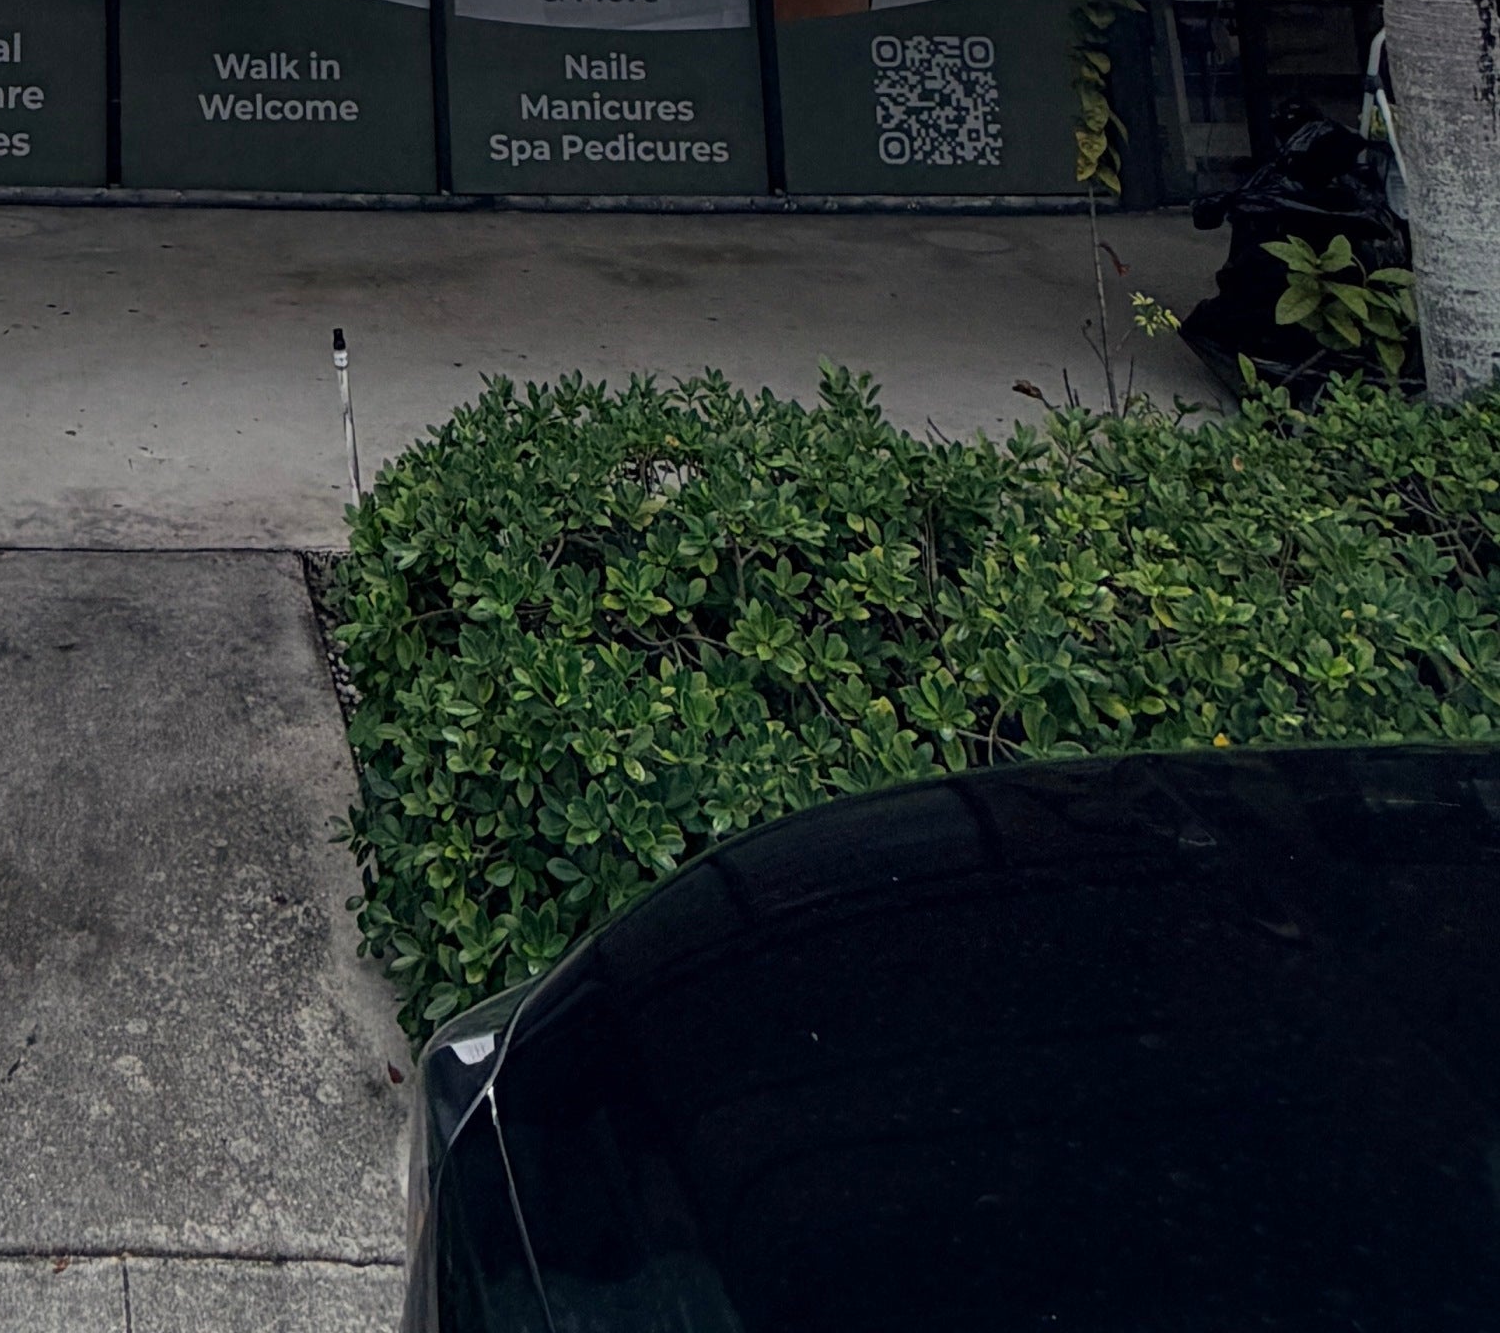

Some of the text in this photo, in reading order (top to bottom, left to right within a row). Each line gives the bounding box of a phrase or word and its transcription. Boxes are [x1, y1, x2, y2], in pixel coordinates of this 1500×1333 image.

[213, 51, 342, 81] Walk in
[563, 52, 647, 81] Nails
[198, 93, 360, 122] Welcome
[520, 91, 696, 122] Manicures
[489, 133, 731, 167] Spa Pedicures
